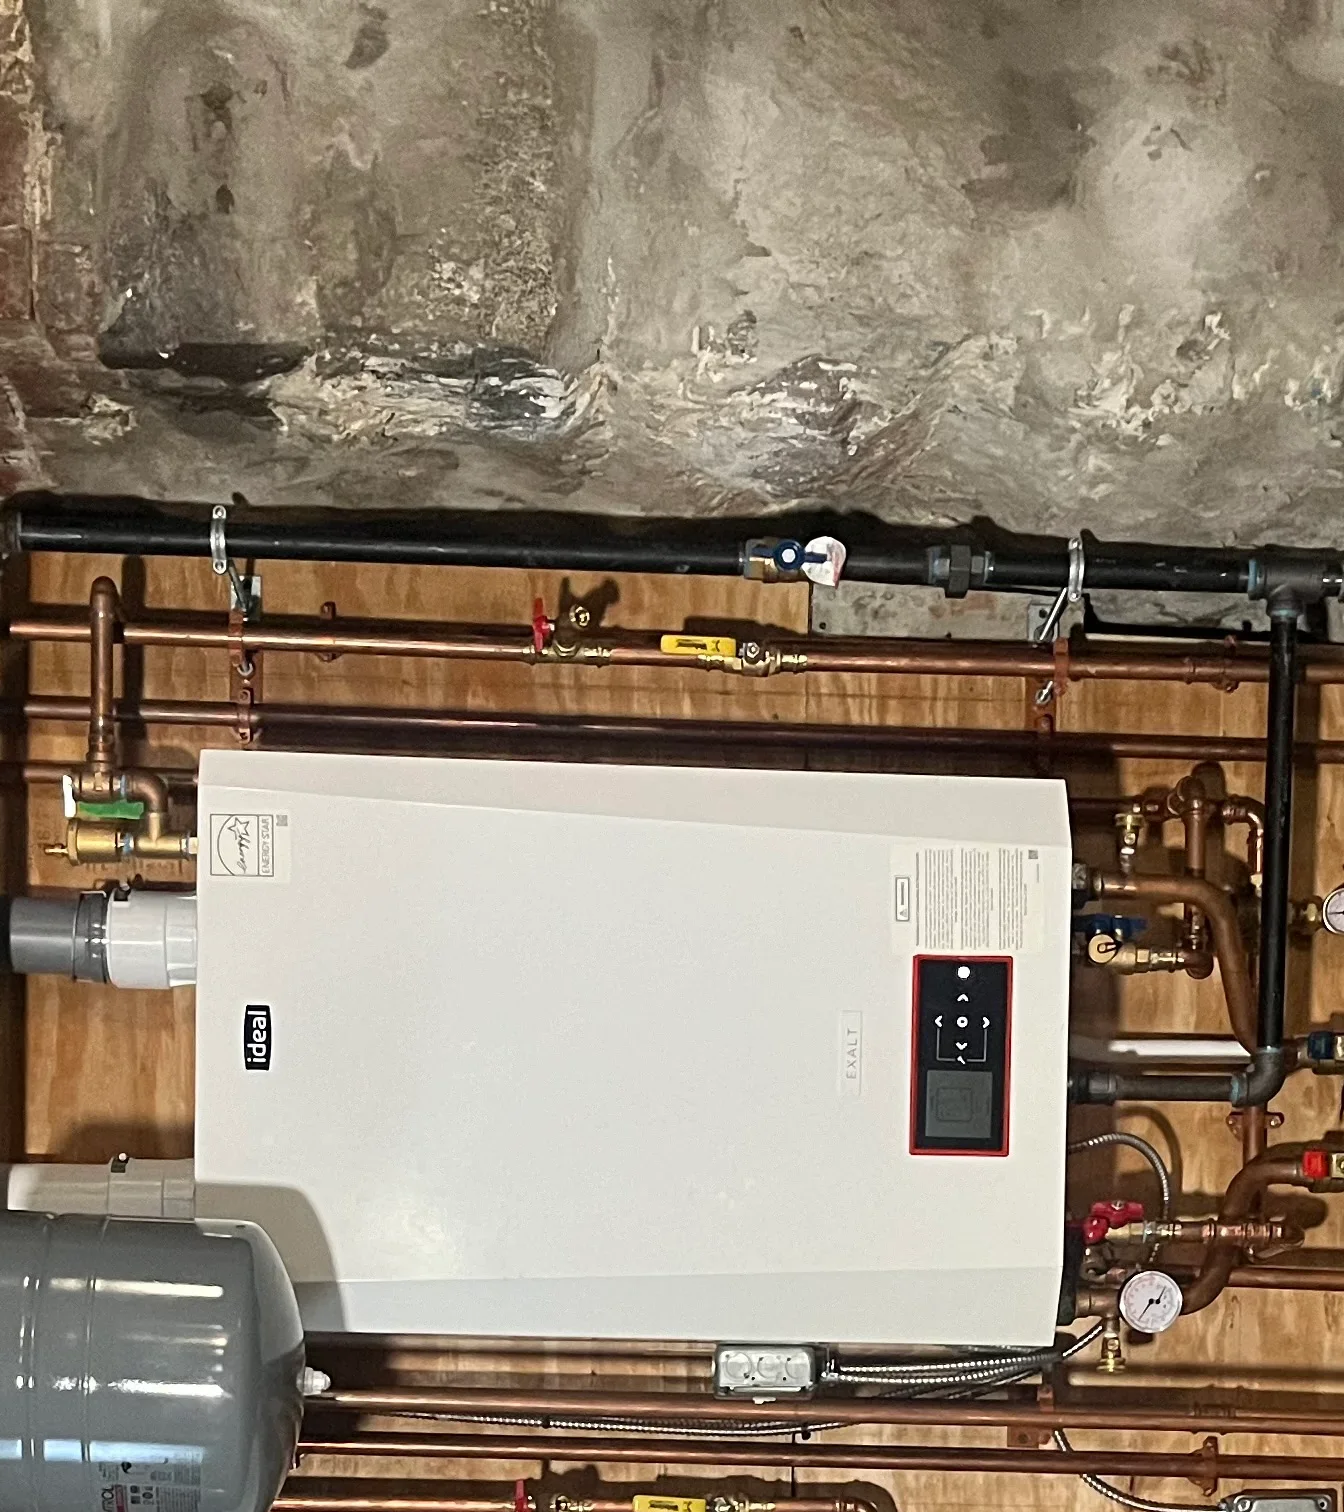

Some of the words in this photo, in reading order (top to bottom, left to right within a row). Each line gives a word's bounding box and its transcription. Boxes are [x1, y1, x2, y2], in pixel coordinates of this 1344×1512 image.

[261, 818, 269, 839] STAR
[261, 841, 270, 874] ENERGY
[247, 1010, 267, 1063] ideal
[846, 1027, 858, 1080] EXALT
